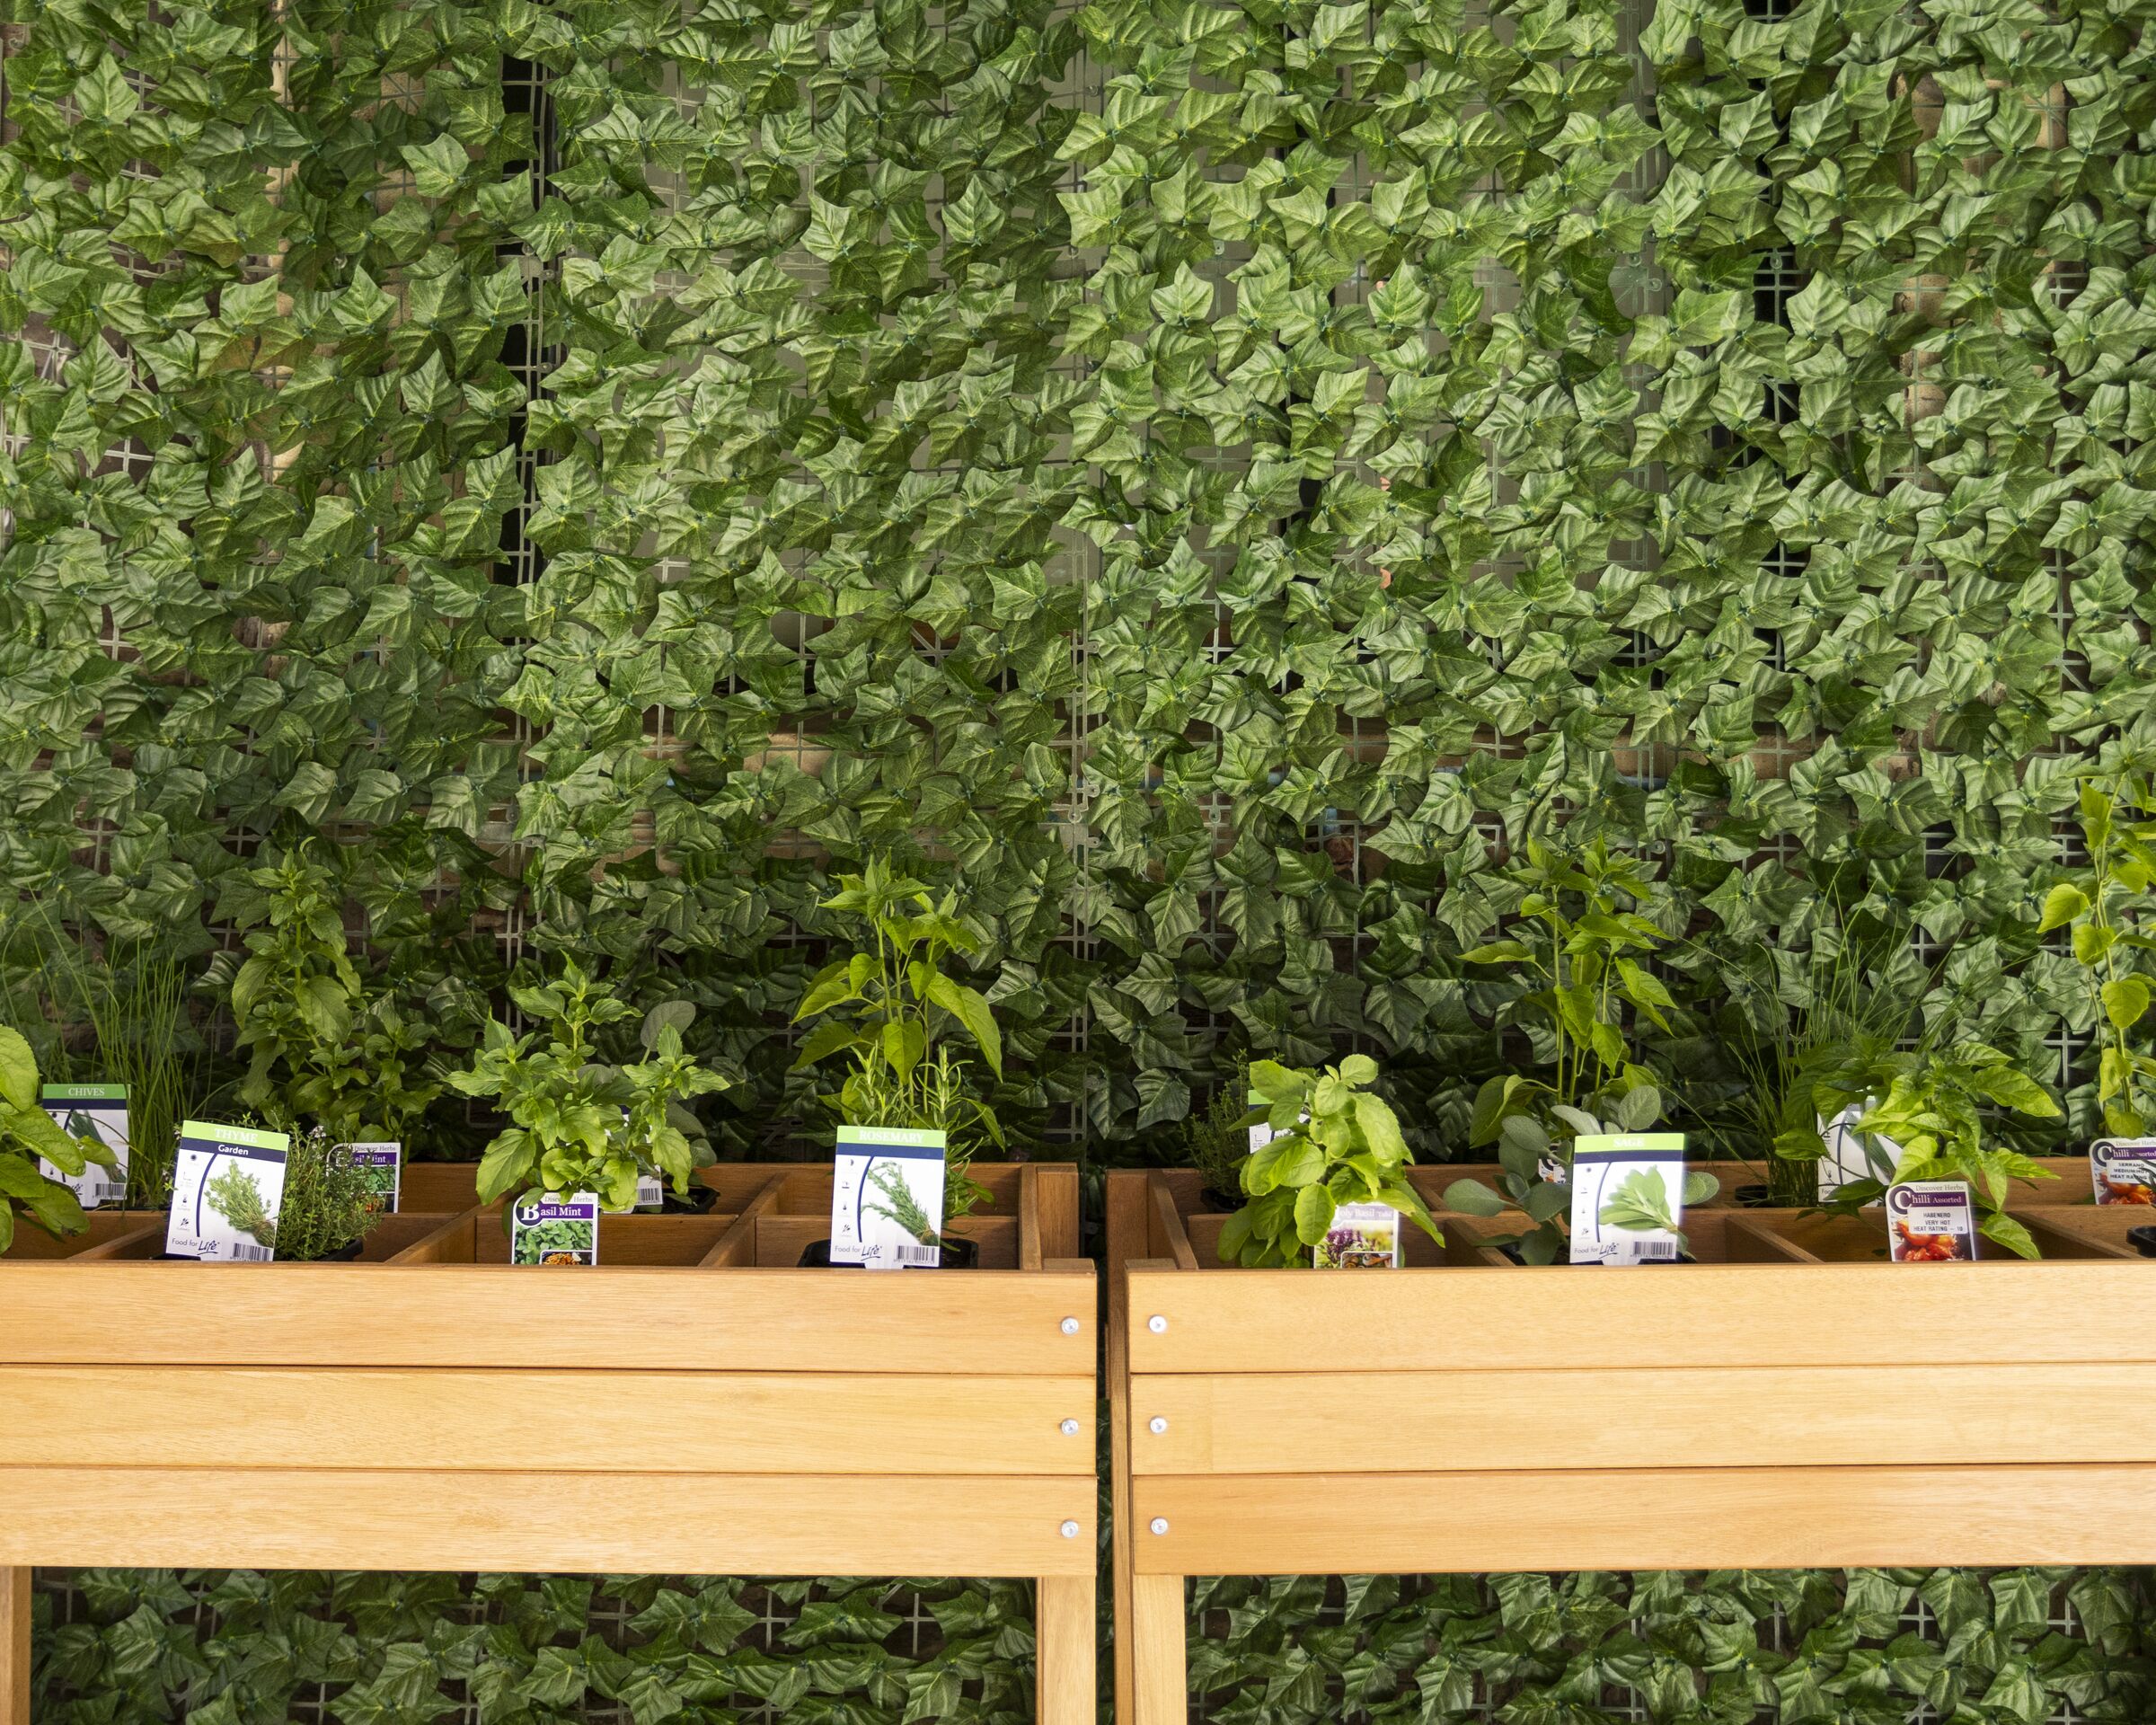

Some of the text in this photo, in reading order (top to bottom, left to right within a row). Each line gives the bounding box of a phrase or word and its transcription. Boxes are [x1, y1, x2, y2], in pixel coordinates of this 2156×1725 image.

[68, 1087, 105, 1096] CHIVES
[215, 1128, 258, 1143] THYME
[859, 1129, 924, 1144] ROSEMARY
[1613, 1137, 1645, 1148] SAGE
[217, 1144, 249, 1155] Garden
[2098, 1146, 2130, 1162] Chilli
[1895, 1190, 1962, 1209] Chilli Assorted
[520, 1202, 582, 1221] Basil Mint
[172, 1237, 217, 1252] Food for Life
[862, 1244, 879, 1256] Life
[1599, 1242, 1617, 1254] Life
